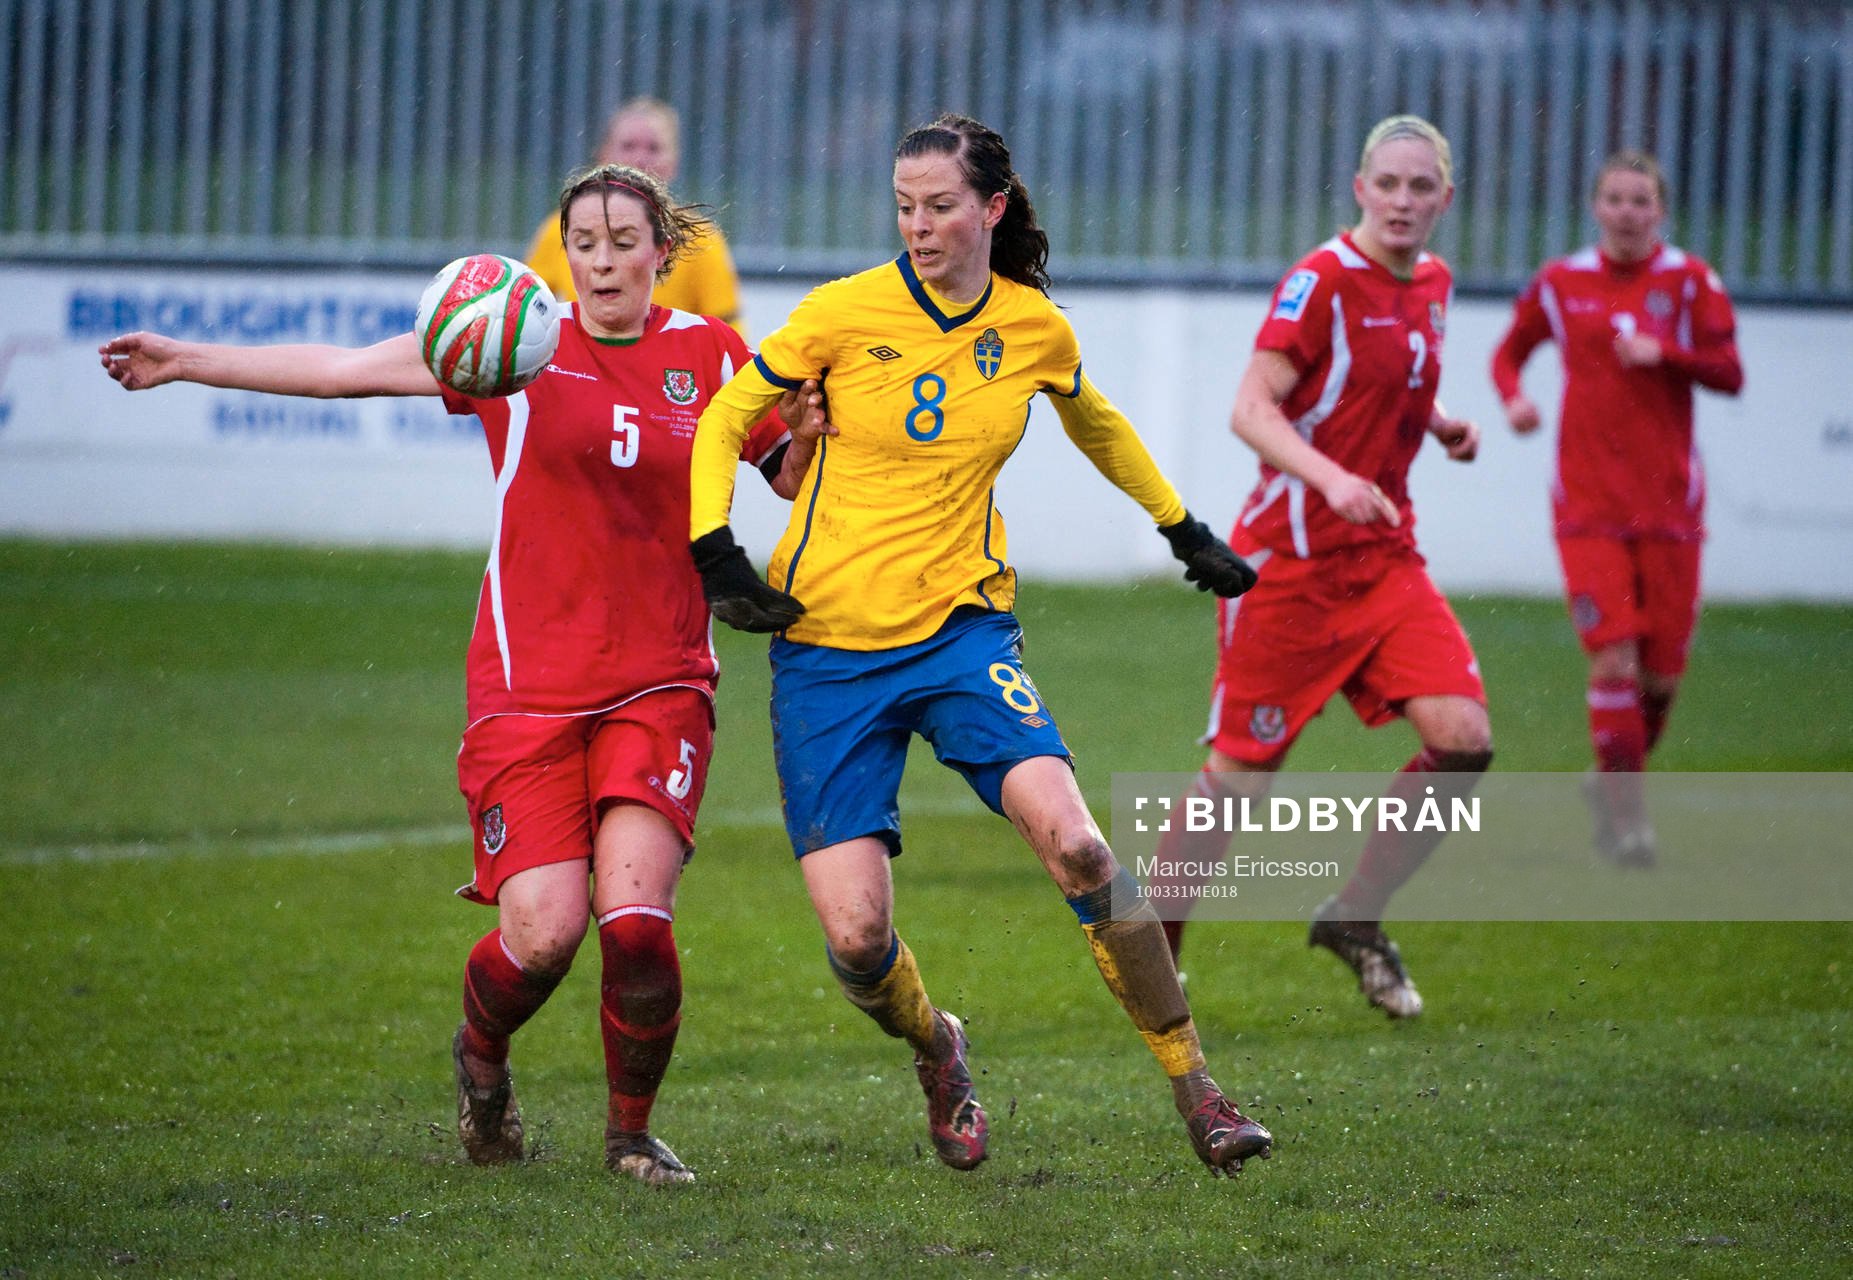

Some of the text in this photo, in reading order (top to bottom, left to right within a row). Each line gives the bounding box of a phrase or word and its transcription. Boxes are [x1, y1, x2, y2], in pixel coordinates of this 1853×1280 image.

[610, 403, 640, 469] 5
[905, 373, 947, 442] 8
[988, 662, 1040, 714] 8
[666, 738, 697, 799] 5
